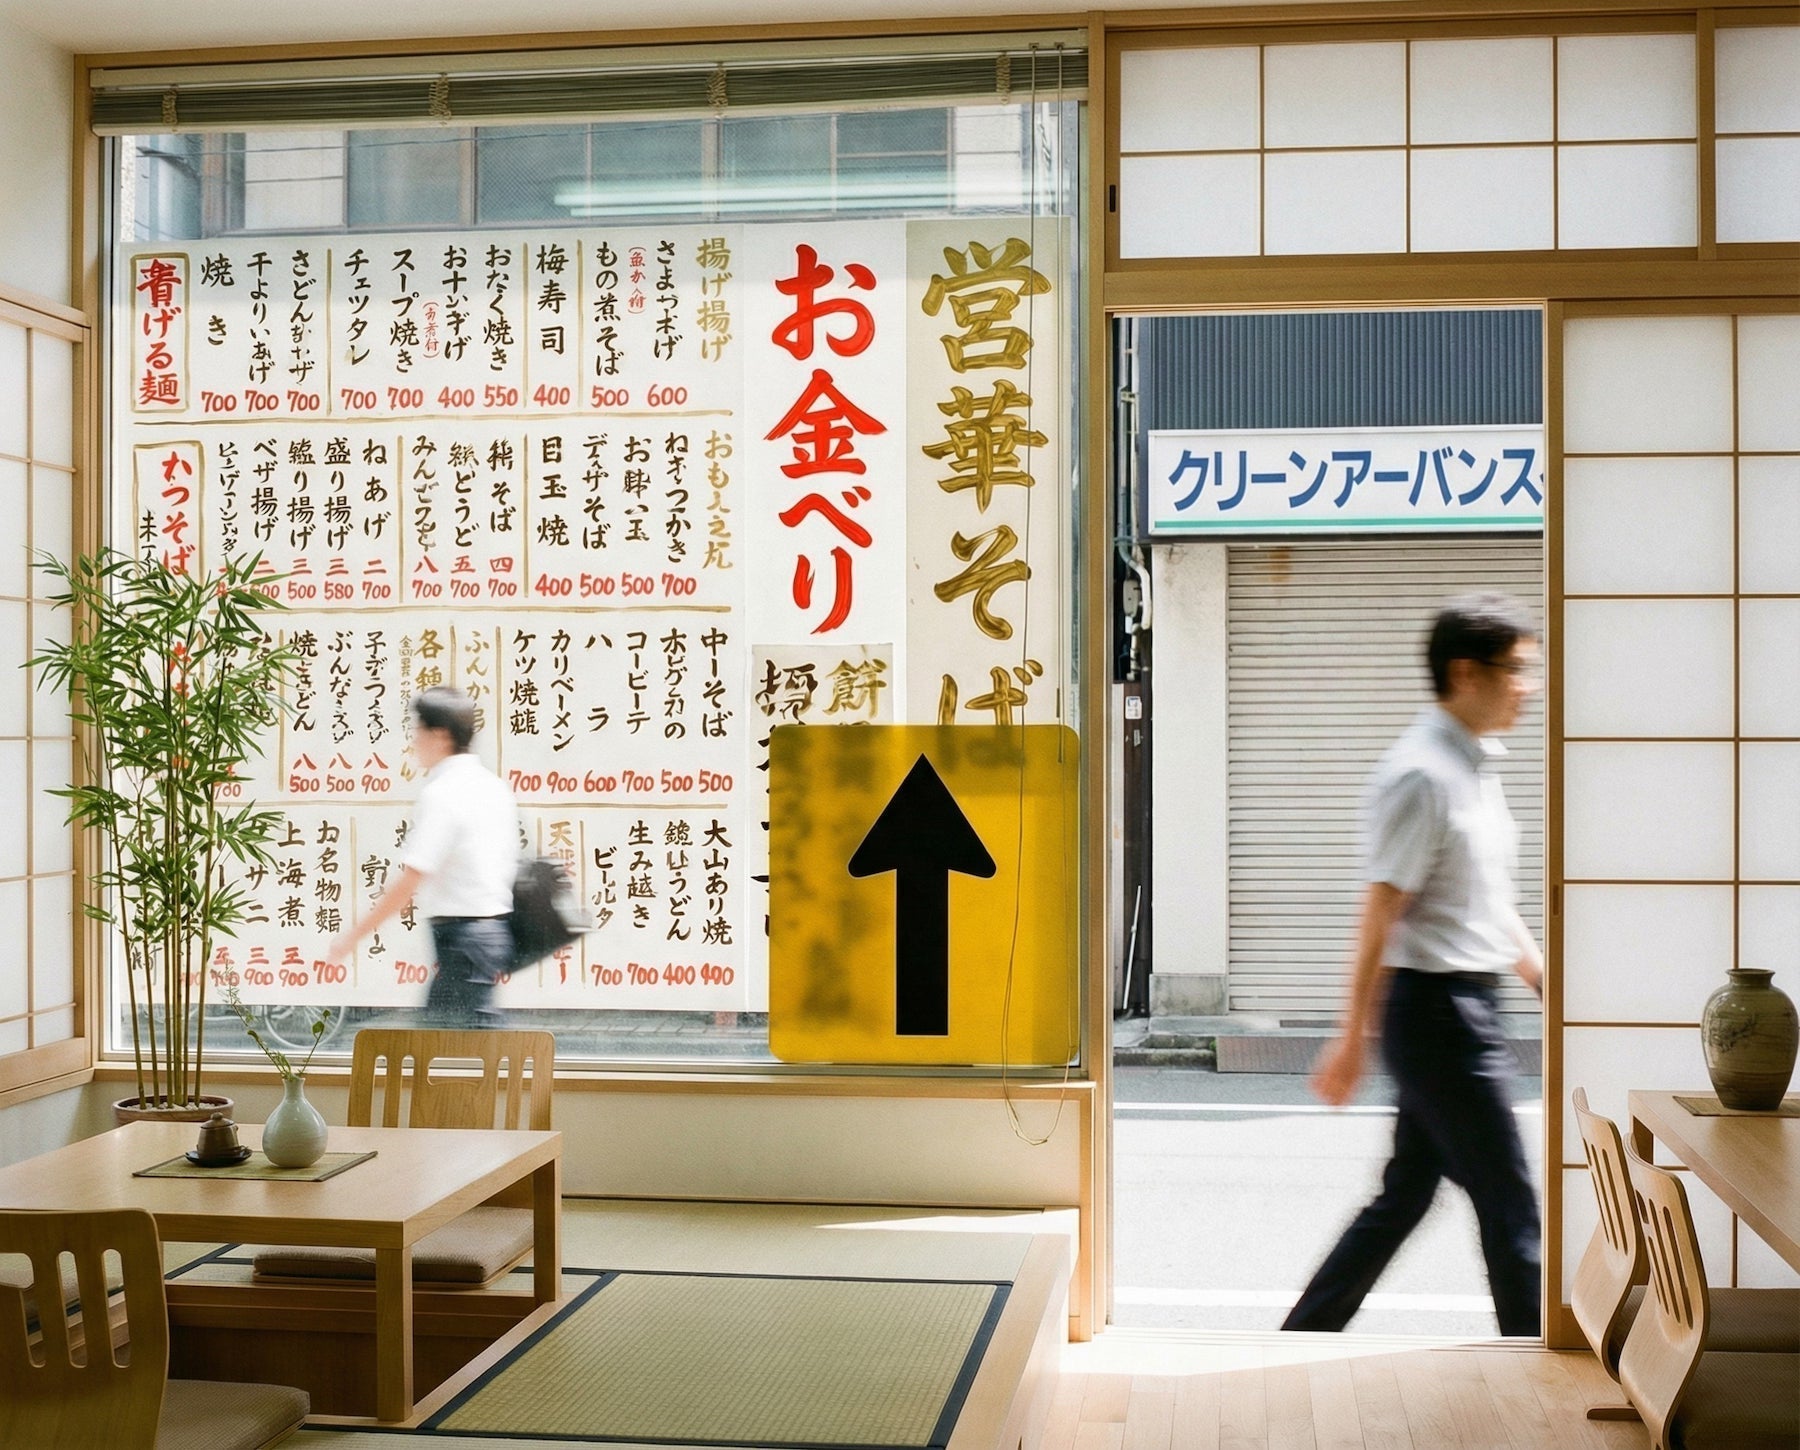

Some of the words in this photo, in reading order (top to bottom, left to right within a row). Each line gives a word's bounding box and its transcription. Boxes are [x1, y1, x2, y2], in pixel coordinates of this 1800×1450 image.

[201, 253, 234, 345] 焼き
[536, 244, 569, 354] 梅寿司
[594, 242, 624, 376] もの煮そば
[390, 249, 419, 372] スープ焼き
[202, 392, 236, 412] 700
[245, 390, 279, 412] 700
[287, 390, 320, 411] 700
[341, 389, 376, 409] 700
[388, 387, 423, 409] 700
[438, 388, 474, 407] 400
[485, 385, 518, 407] 550
[534, 385, 570, 406] 400
[592, 386, 628, 408] 500
[648, 385, 687, 407] 600
[764, 244, 887, 634] お金べり
[1168, 444, 1543, 512] クリーンアーバンス
[324, 437, 353, 550] 盛り揚げ
[363, 439, 391, 539] ねあげ
[537, 436, 569, 545] 目玉焼
[289, 559, 311, 575] 三
[327, 559, 348, 576] 三
[364, 560, 386, 574] 二
[416, 556, 438, 573] 八
[452, 556, 475, 573] 五
[490, 557, 513, 572] 四
[288, 582, 316, 599] 500
[325, 582, 353, 600] 580
[362, 582, 390, 599] 700
[412, 580, 442, 597] 700
[451, 580, 480, 597] 700
[489, 579, 517, 596] 700
[535, 574, 572, 596] 400
[580, 573, 615, 597] 500
[622, 573, 654, 596] 500
[662, 573, 696, 596] 700
[551, 630, 574, 751] カリベーメン
[585, 635, 612, 731] ハラ
[627, 632, 650, 734] コービーテ
[701, 628, 732, 737] 中ーそば
[294, 754, 316, 770] 八
[330, 755, 351, 769] 八
[366, 753, 388, 769] 八
[290, 775, 319, 792] 500
[327, 775, 354, 791] 500
[362, 775, 390, 791] 900
[510, 771, 541, 791] 700
[547, 772, 577, 792] 900
[584, 771, 617, 792] 600
[623, 770, 654, 792] 700
[661, 770, 693, 792] 500
[699, 770, 732, 793] 500
[277, 821, 306, 927] 上海煮
[702, 820, 732, 944] 大山あり焼
[245, 969, 272, 985] 900
[280, 970, 308, 986] 900
[314, 961, 345, 982] 700
[592, 965, 622, 984] 700
[628, 963, 658, 984] 700
[663, 964, 696, 985] 400
